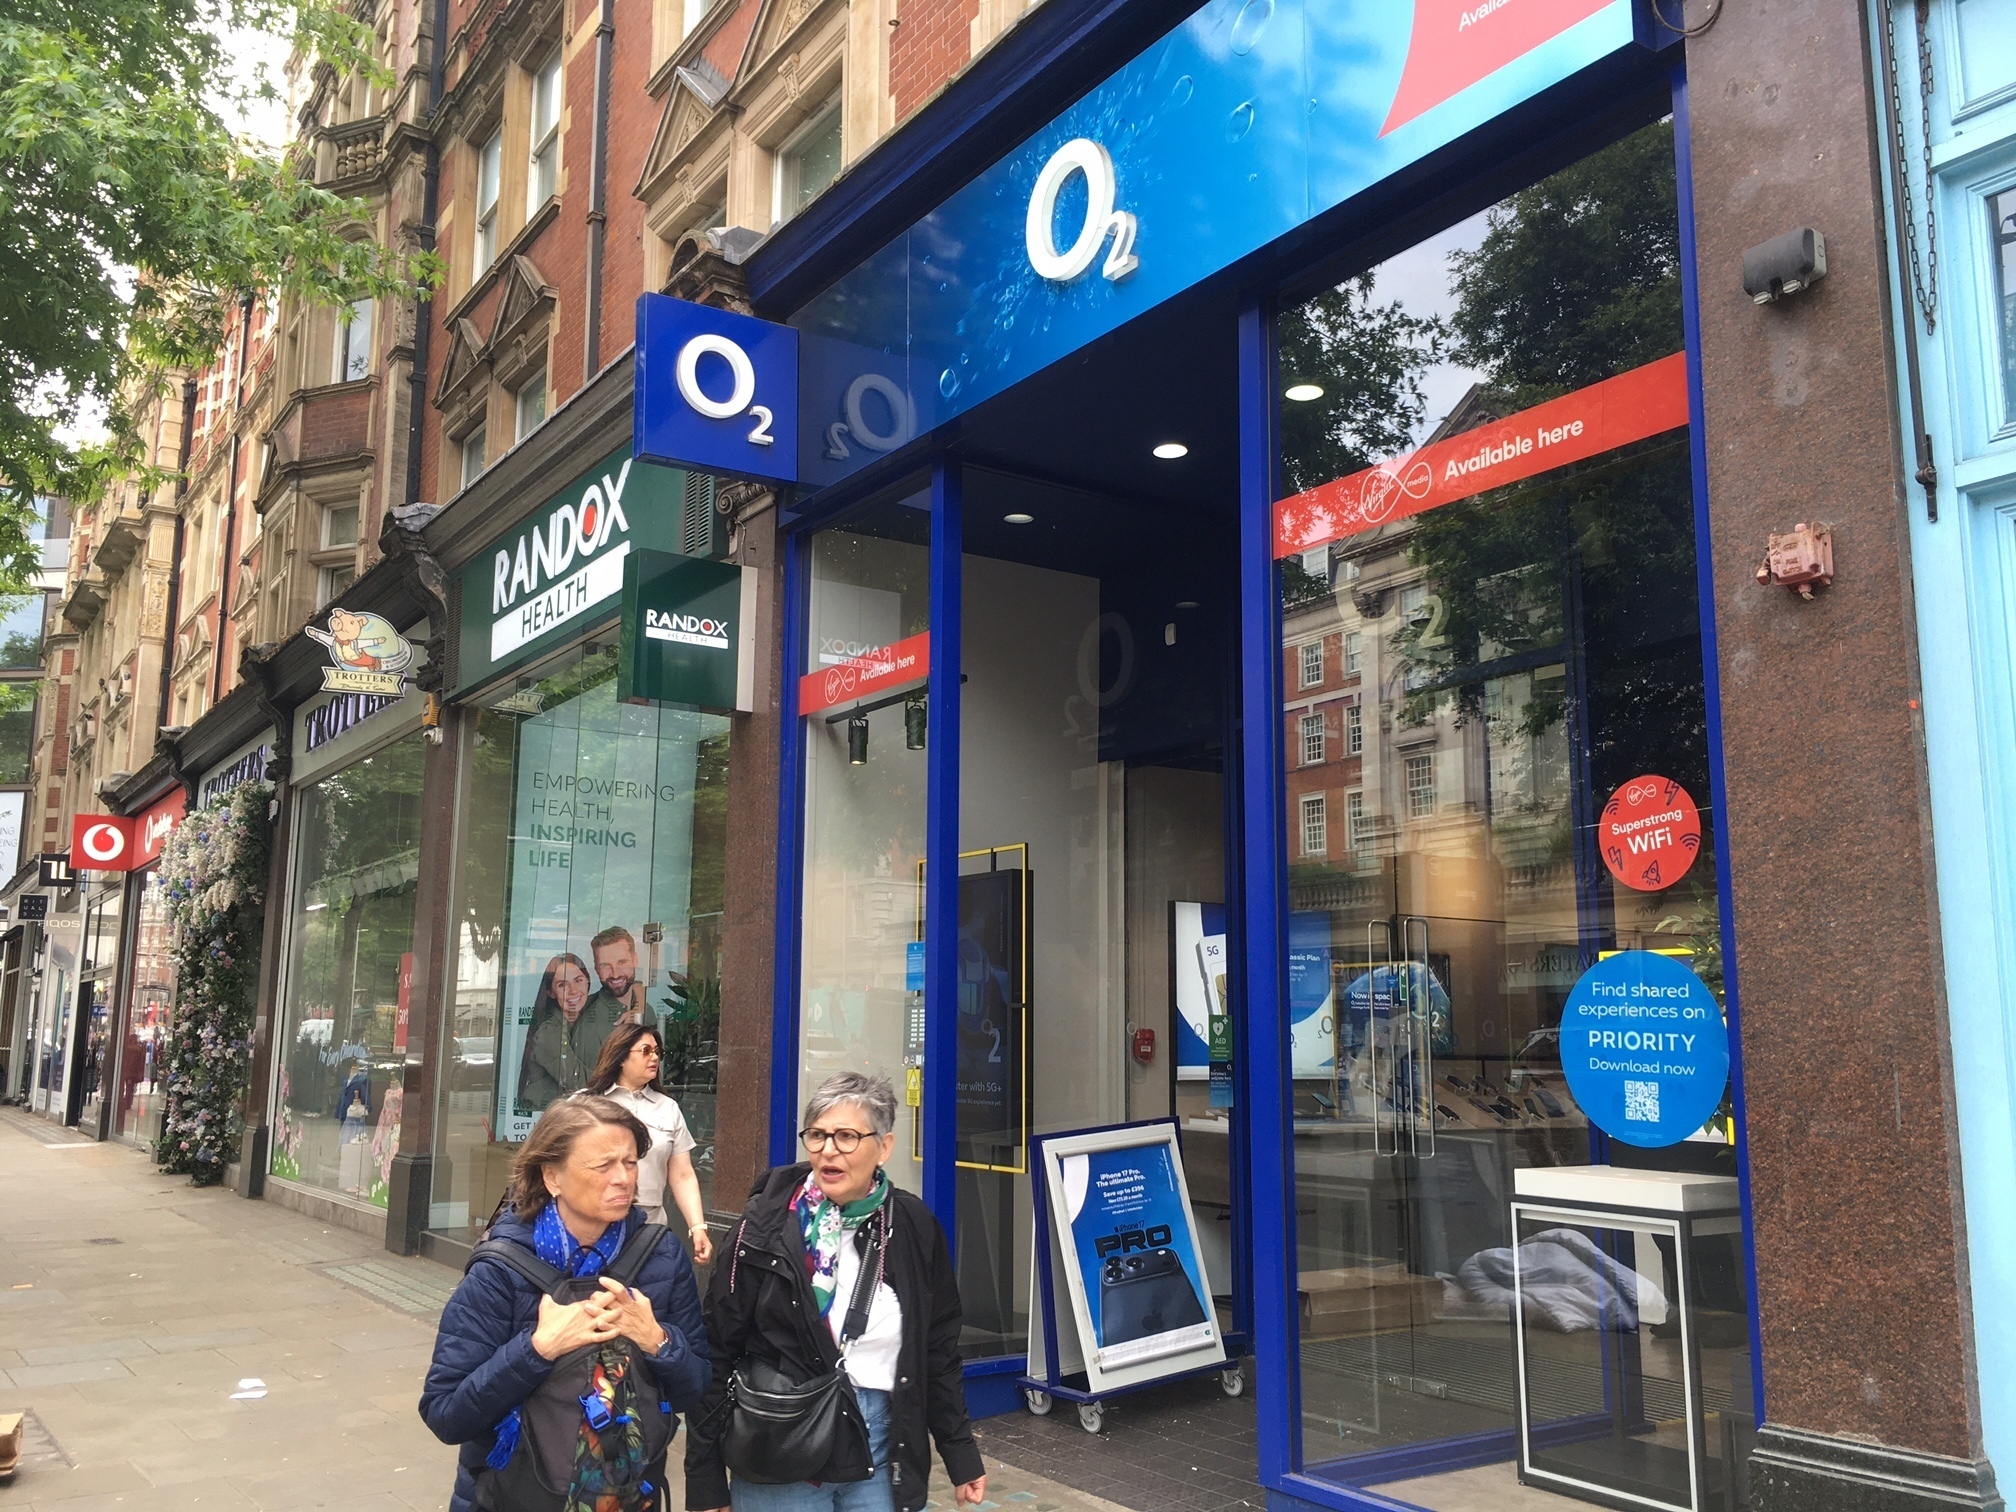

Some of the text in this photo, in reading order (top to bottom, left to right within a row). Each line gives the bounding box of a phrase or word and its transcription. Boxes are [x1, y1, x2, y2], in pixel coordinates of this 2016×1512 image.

[1364, 420, 1584, 513] Virgin media Available here
[493, 457, 633, 615] RANDOX
[521, 571, 588, 639] HEALTH
[646, 608, 729, 637] RANDOX
[667, 631, 708, 645] HEALTH
[334, 671, 394, 684] TROTTERS
[859, 660, 895, 683] Available
[896, 655, 916, 669] here
[533, 771, 675, 802] EMPOWERING
[532, 798, 615, 825] HEALTH,
[1611, 809, 1682, 836] Superstrong
[530, 823, 637, 849] INSPIRING
[1627, 827, 1673, 855] WiFi
[528, 849, 570, 869] LIFE
[45, 918, 81, 928] IQOS
[1206, 945, 1219, 956] 5G
[1306, 953, 1321, 962] Plan
[1351, 991, 1368, 999] Now
[1592, 982, 1690, 998] Find shared
[1577, 1002, 1705, 1020] experiences on
[1214, 1037, 1227, 1045] AED
[1588, 1030, 1696, 1052] PRIORITY
[1589, 1057, 1696, 1076] Download now
[969, 1081, 986, 1092] with
[986, 1081, 1003, 1093] 5G+
[513, 1122, 531, 1130] GET
[514, 1133, 527, 1142] TO
[1100, 1168, 1141, 1181] iPhone 17 Pro.
[1109, 1176, 1134, 1186] ultimate
[1119, 1220, 1145, 1232] iPhone 17
[1094, 1224, 1173, 1259] PRO
